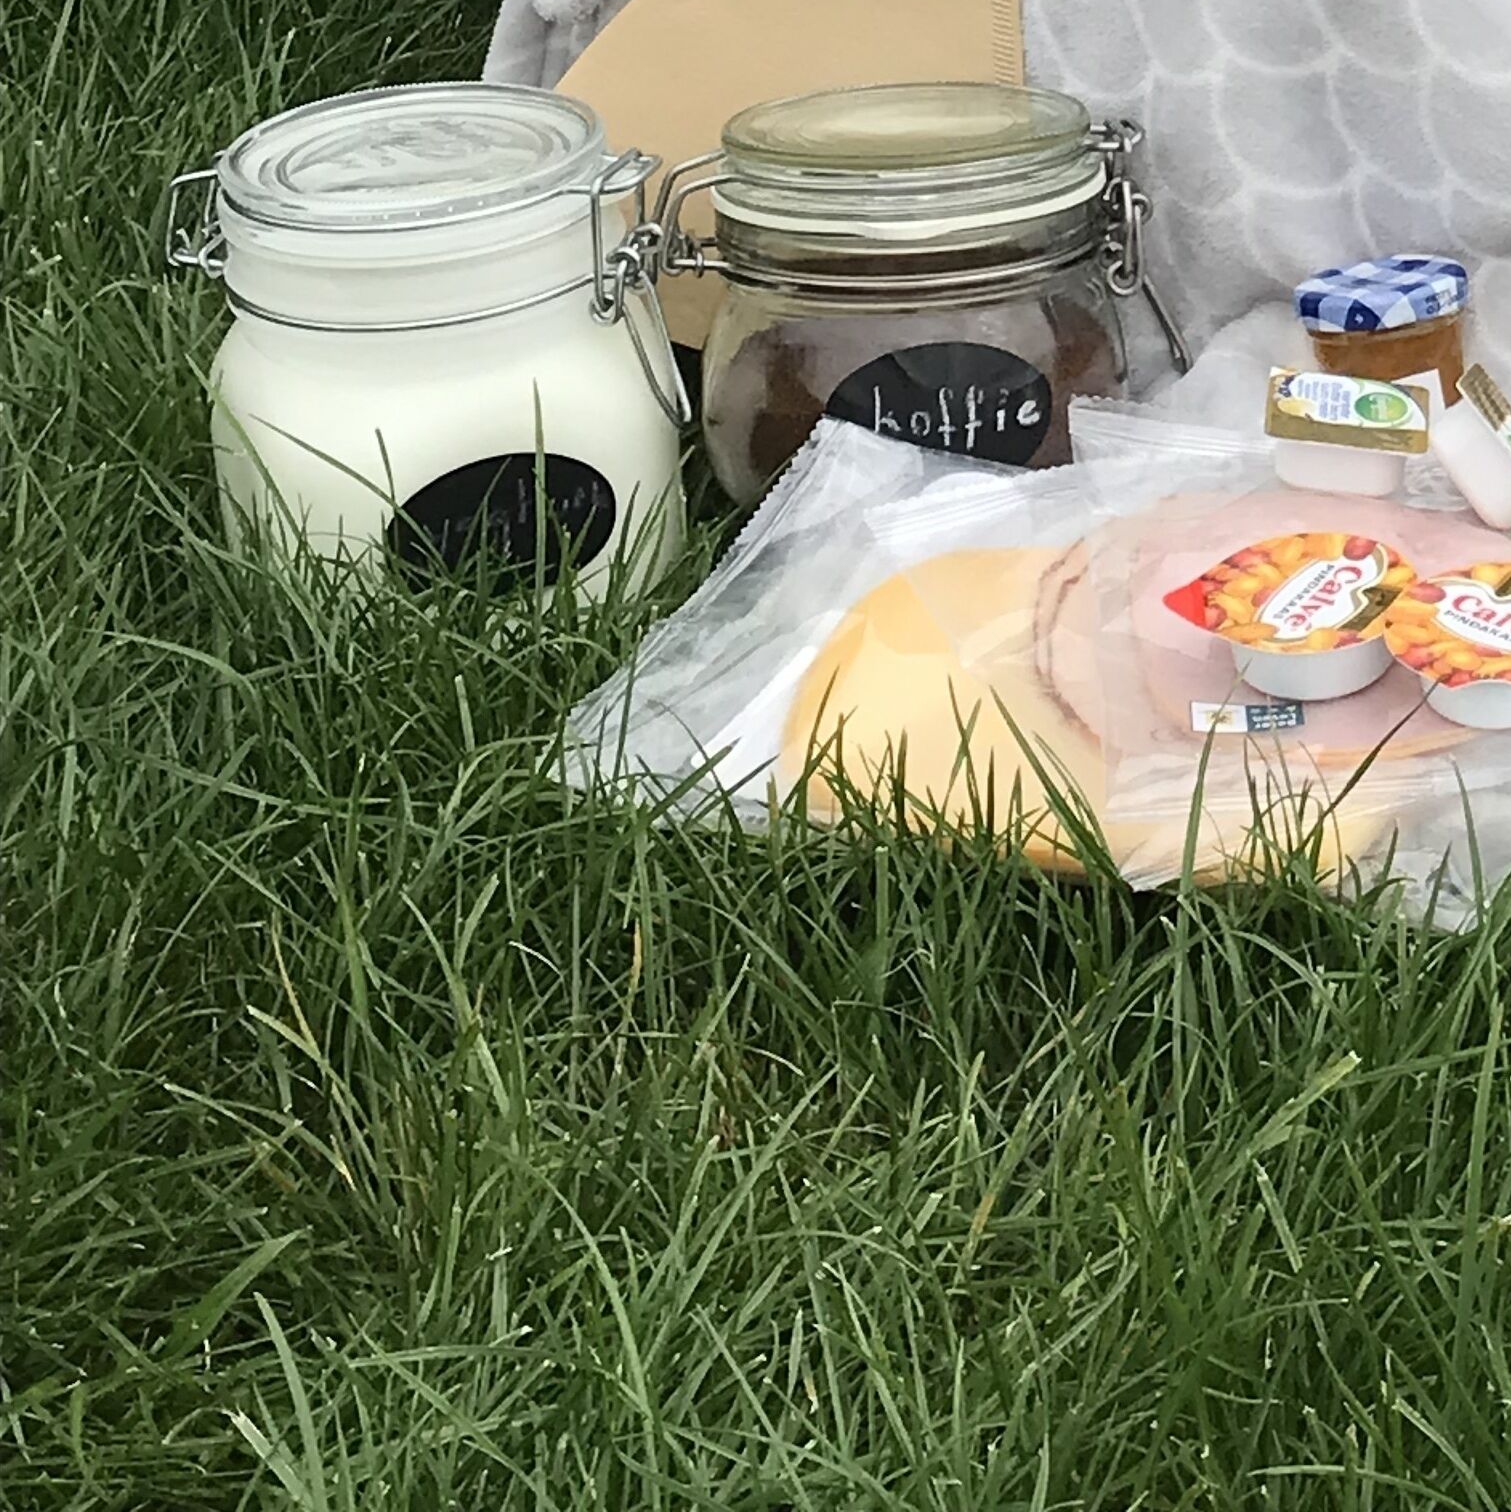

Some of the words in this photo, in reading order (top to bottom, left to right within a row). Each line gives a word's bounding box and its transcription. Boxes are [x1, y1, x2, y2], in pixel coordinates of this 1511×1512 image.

[873, 382, 1042, 451] koffie
[1273, 564, 1336, 620] PINDAKAAS
[1284, 564, 1363, 631] Calvé
